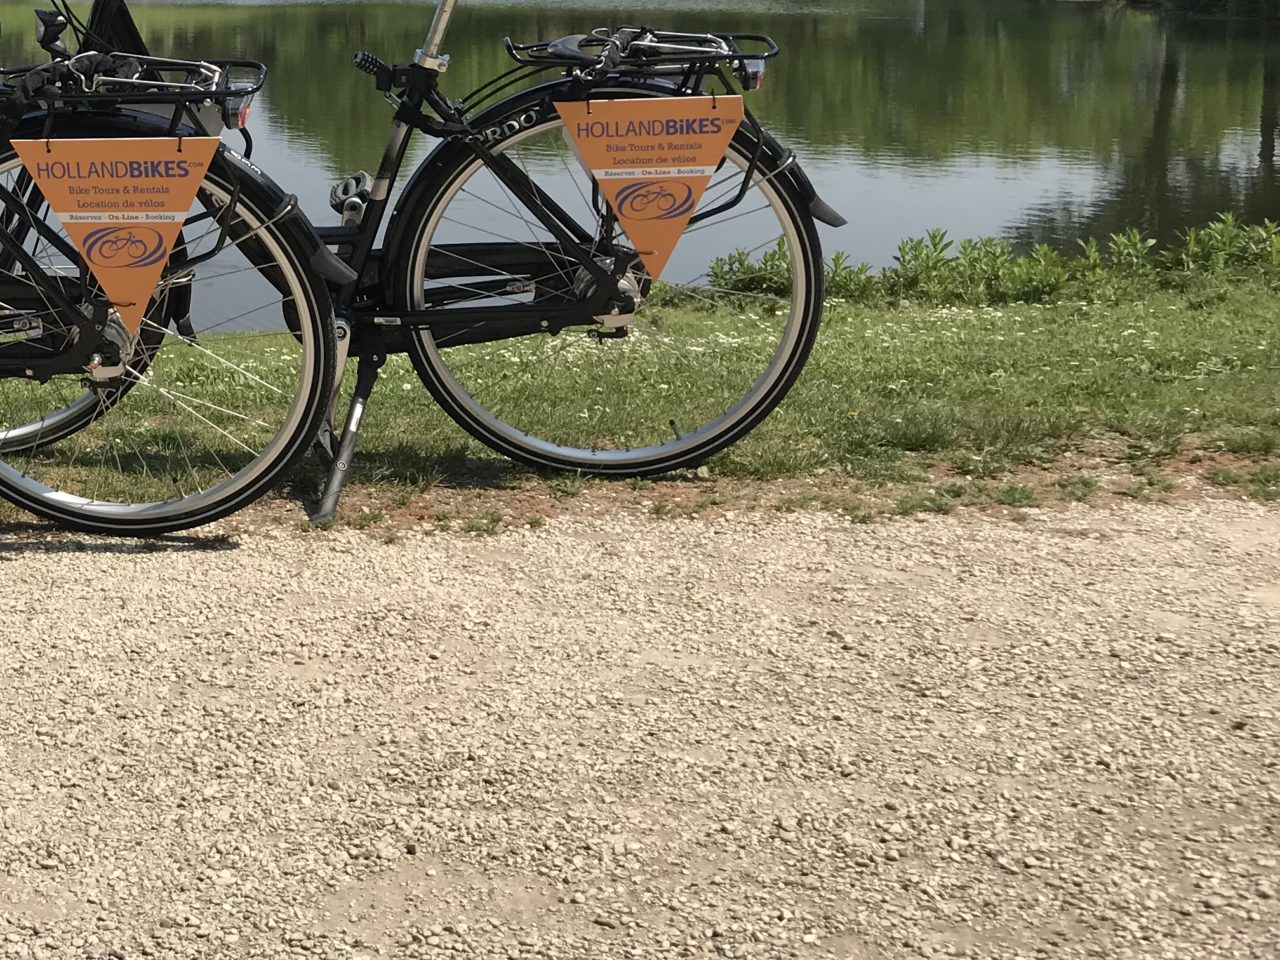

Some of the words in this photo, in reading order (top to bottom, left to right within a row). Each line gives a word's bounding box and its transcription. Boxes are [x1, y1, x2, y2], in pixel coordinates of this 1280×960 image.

[606, 144, 626, 153] Bike
[628, 143, 655, 152] Tours
[657, 143, 665, 151] &
[667, 142, 702, 151] Rentals
[613, 156, 653, 165] Location
[656, 156, 668, 164] de
[671, 155, 696, 163] vélos
[68, 186, 90, 195] Bike
[92, 186, 120, 195] Tours
[122, 186, 131, 195] &
[133, 186, 170, 195] Rentals
[77, 200, 119, 209] Location
[122, 200, 135, 208] de
[138, 199, 165, 208] vélos
